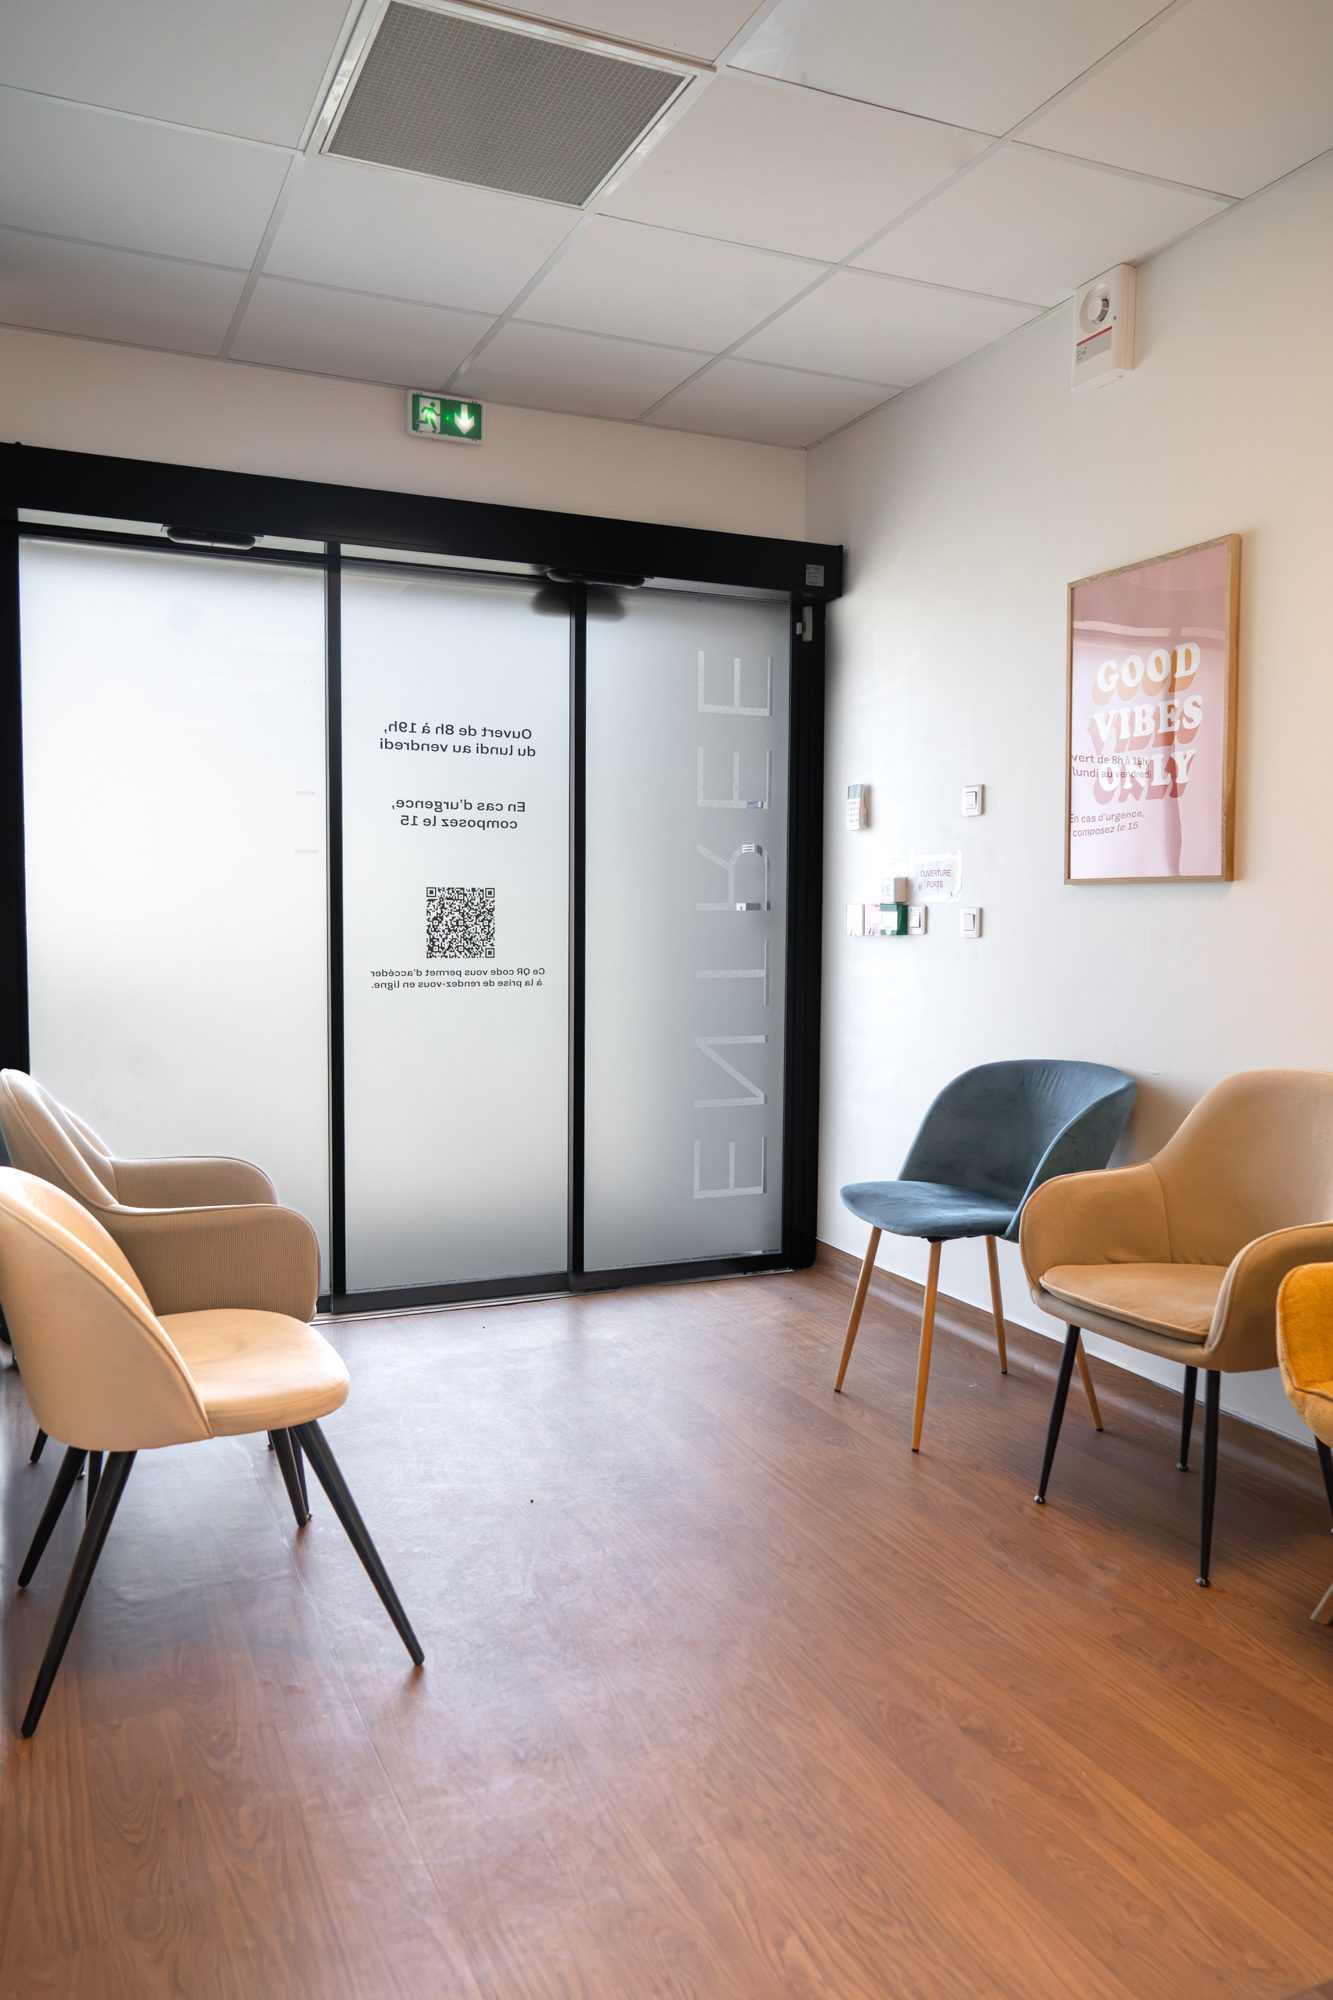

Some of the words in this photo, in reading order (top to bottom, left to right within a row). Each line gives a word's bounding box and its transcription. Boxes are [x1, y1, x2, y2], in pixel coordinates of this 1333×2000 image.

[1095, 642, 1200, 697] GOOD
[1092, 695, 1203, 745] VIBES
[1097, 754, 1110, 764] de
[1111, 755, 1123, 765] 8h
[1072, 767, 1099, 778] lundi
[1098, 750, 1196, 794] ONLY
[1081, 815, 1096, 823] cas
[1098, 811, 1144, 823] d'urgence,
[1072, 826, 1115, 838] composez
[1117, 824, 1125, 833] le
[1128, 821, 1139, 831] 15
[920, 869, 951, 877] OUVERTURE
[927, 880, 943, 888] PORTE
